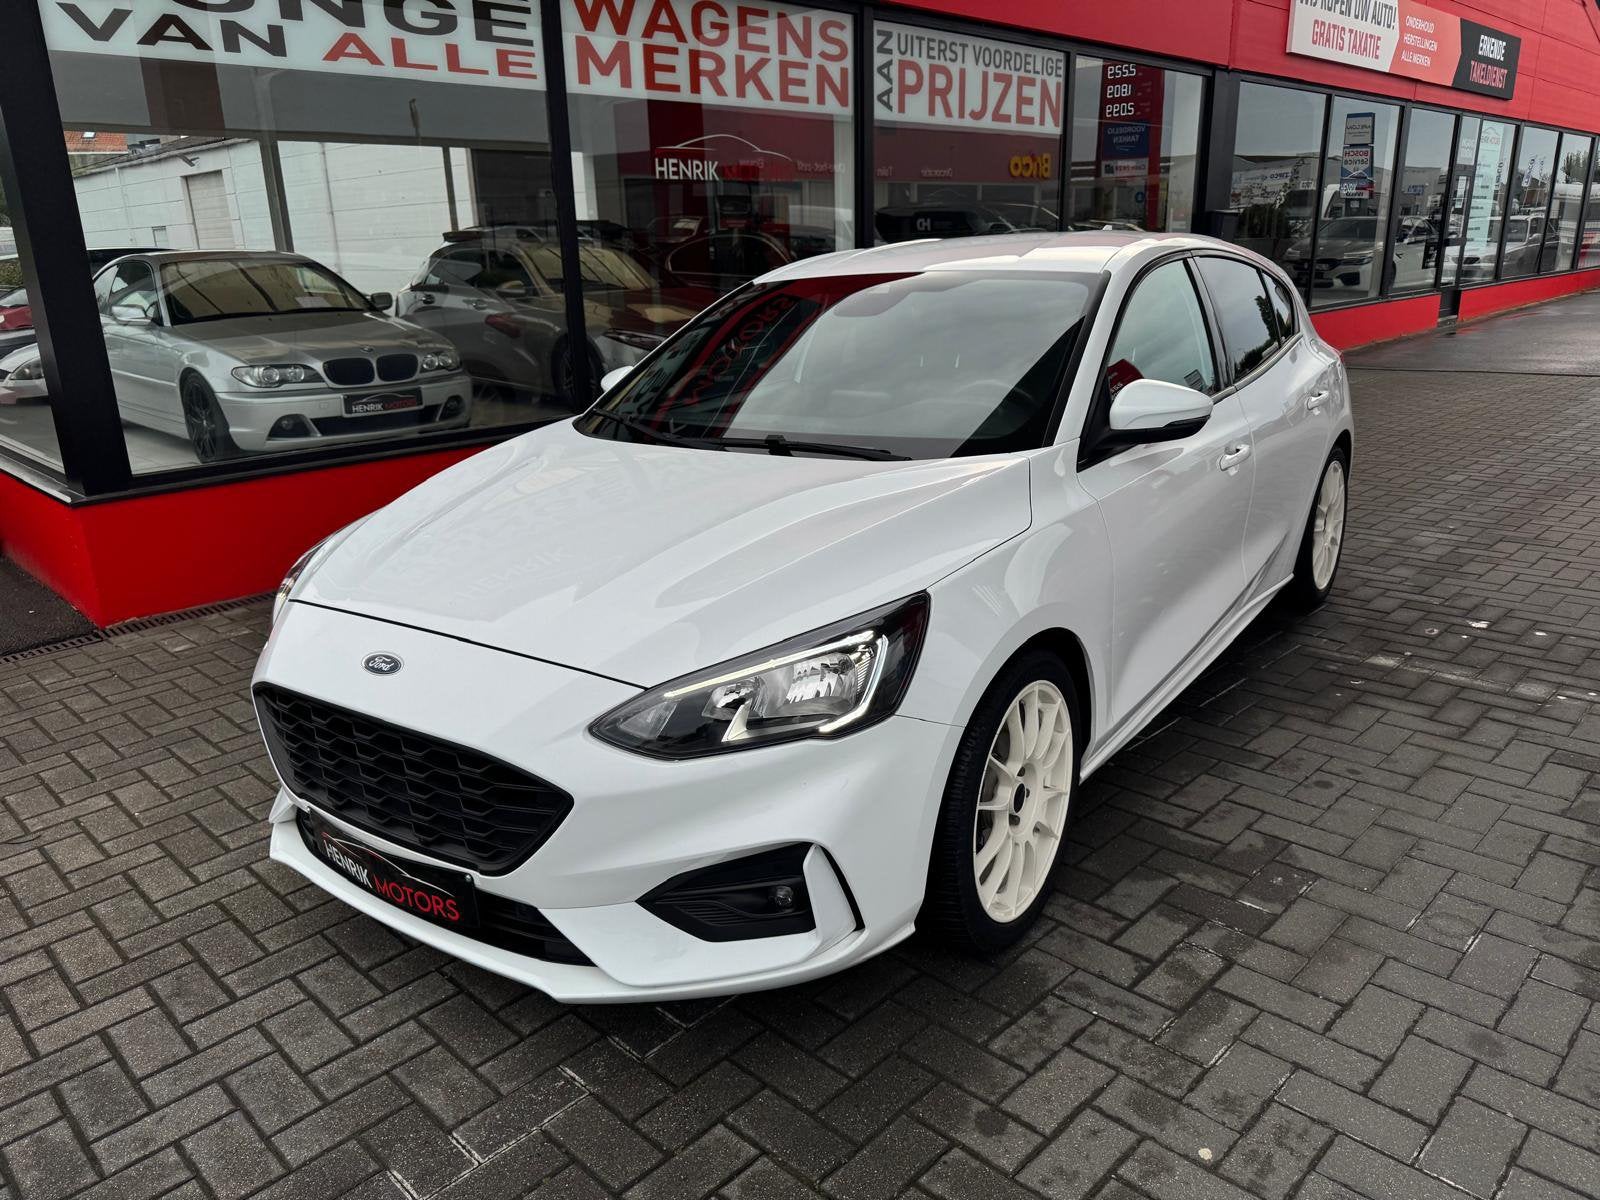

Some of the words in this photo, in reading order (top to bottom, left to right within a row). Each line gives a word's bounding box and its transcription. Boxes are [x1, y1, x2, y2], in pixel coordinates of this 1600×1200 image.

[172, 0, 534, 47] NGE
[573, 0, 849, 63] WAGENS
[1354, 0, 1371, 22] UW
[1371, 1, 1397, 30] AUTO!
[1406, 15, 1435, 34] ONDERHOUD
[56, 2, 287, 57] VAN
[322, 33, 537, 79] ALLE
[897, 32, 968, 64] UITERST
[973, 44, 1063, 78] VOORDELIGE
[1312, 19, 1345, 52] GRATIS
[1348, 29, 1381, 60] TAXATIE
[1404, 33, 1438, 52] HERSTELLINGEN
[1478, 34, 1506, 62] ERKENDE
[575, 35, 849, 107] MERKEN
[876, 29, 893, 113] AAN
[1469, 60, 1508, 89] TAKELDIENST
[897, 59, 1062, 128] PRIJZEN
[655, 157, 720, 181] HENRIK
[352, 403, 384, 413] HENRIK
[369, 656, 395, 671] Ford
[323, 840, 373, 889] HENRIK
[373, 874, 460, 921] MOTORS
